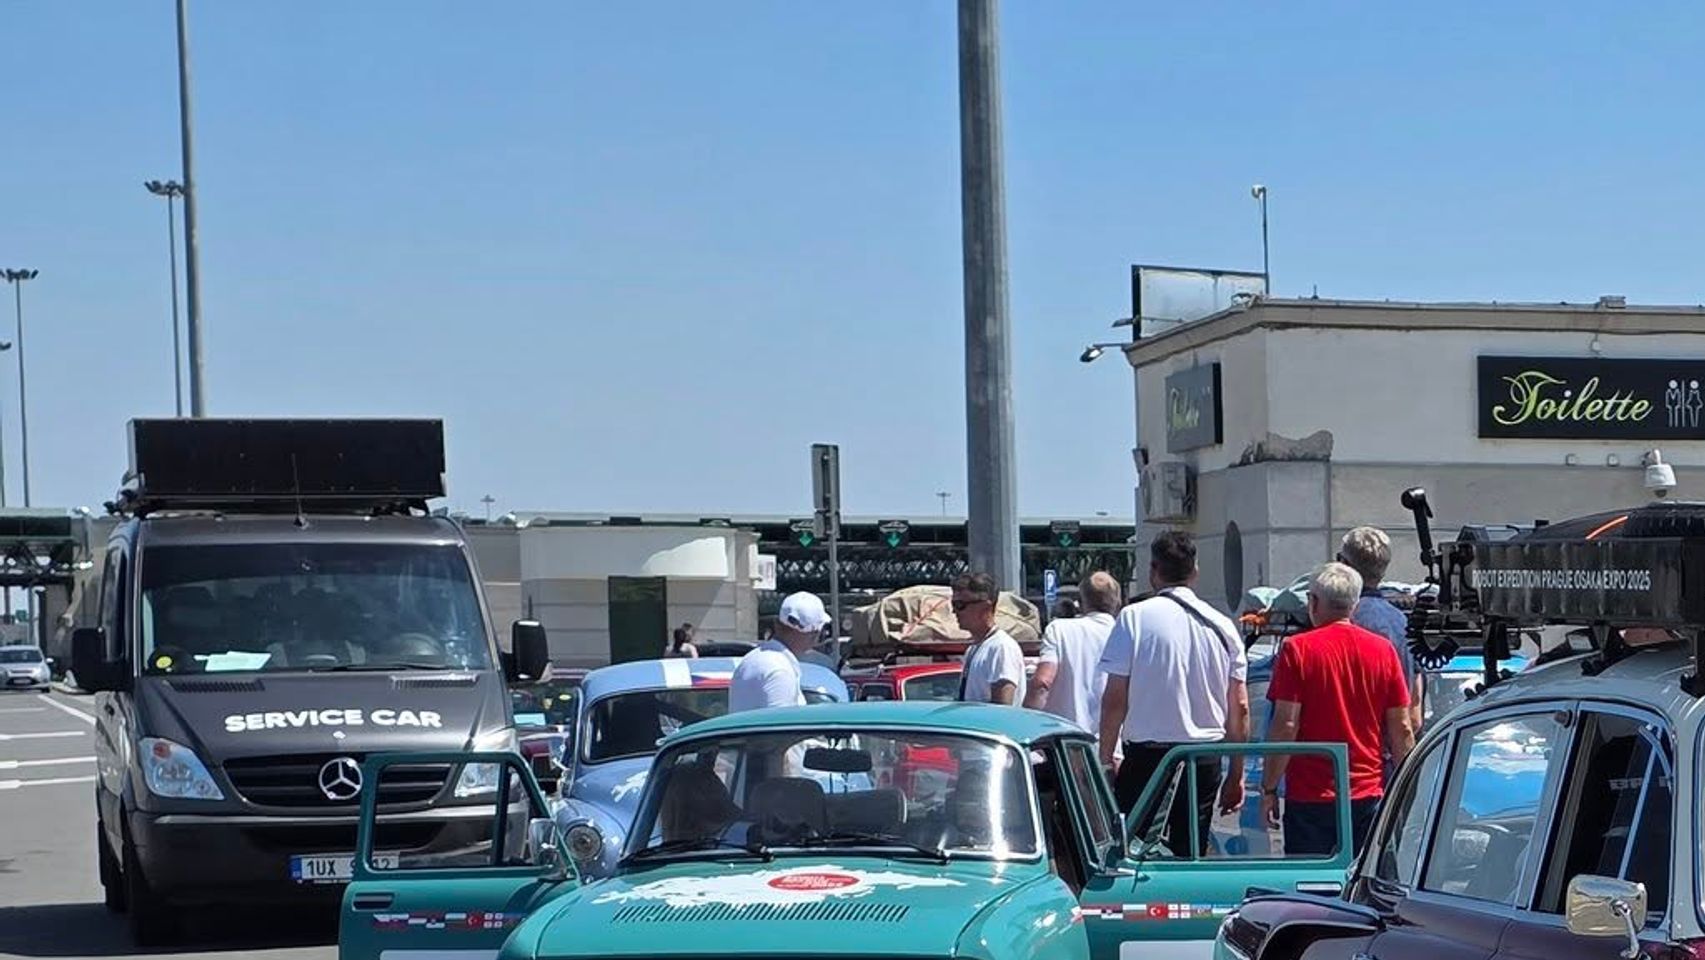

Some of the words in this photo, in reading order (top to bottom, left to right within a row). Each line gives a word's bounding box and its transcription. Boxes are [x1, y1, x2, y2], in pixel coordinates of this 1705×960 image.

[1491, 370, 1654, 425] Toilette
[1498, 569, 1541, 588] EXPEDITION
[1542, 569, 1574, 589] PRAGUE
[1574, 570, 1602, 589] OSAKA
[1603, 570, 1627, 590] EXPO
[1627, 570, 1651, 590] 2025
[224, 709, 364, 732] SERVICE
[370, 709, 443, 728] CAR
[306, 860, 337, 876] 1UX
